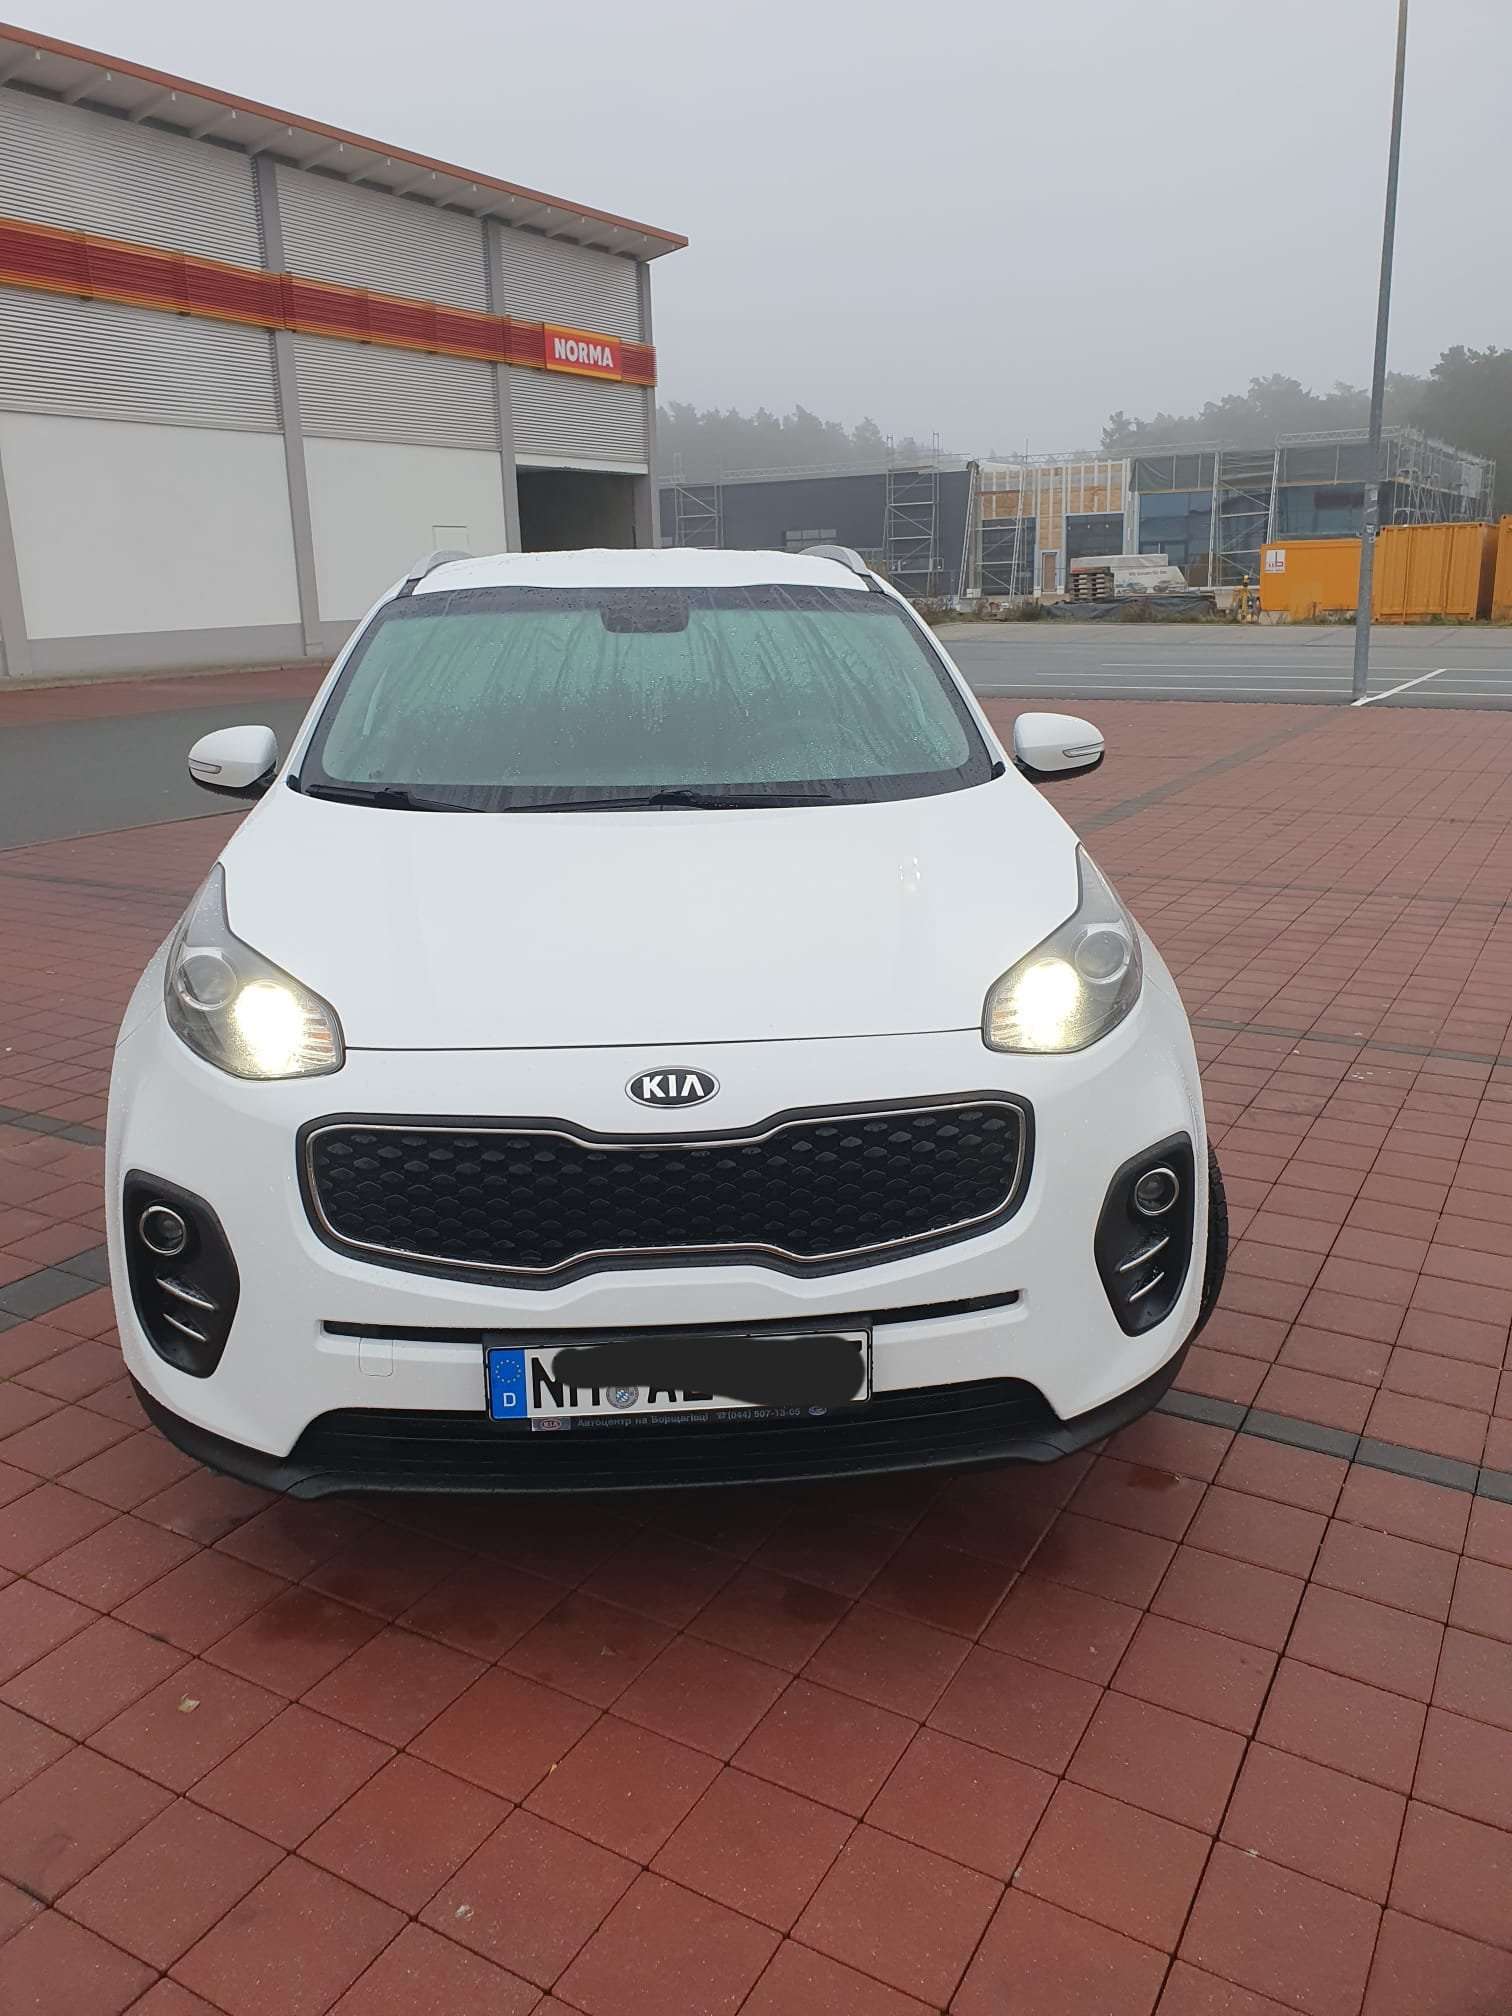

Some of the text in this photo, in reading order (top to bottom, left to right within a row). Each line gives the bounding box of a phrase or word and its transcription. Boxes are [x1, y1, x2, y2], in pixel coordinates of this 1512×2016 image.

[553, 338, 614, 368] NORMA
[642, 1074, 705, 1099] KIA
[503, 1392, 516, 1407] D
